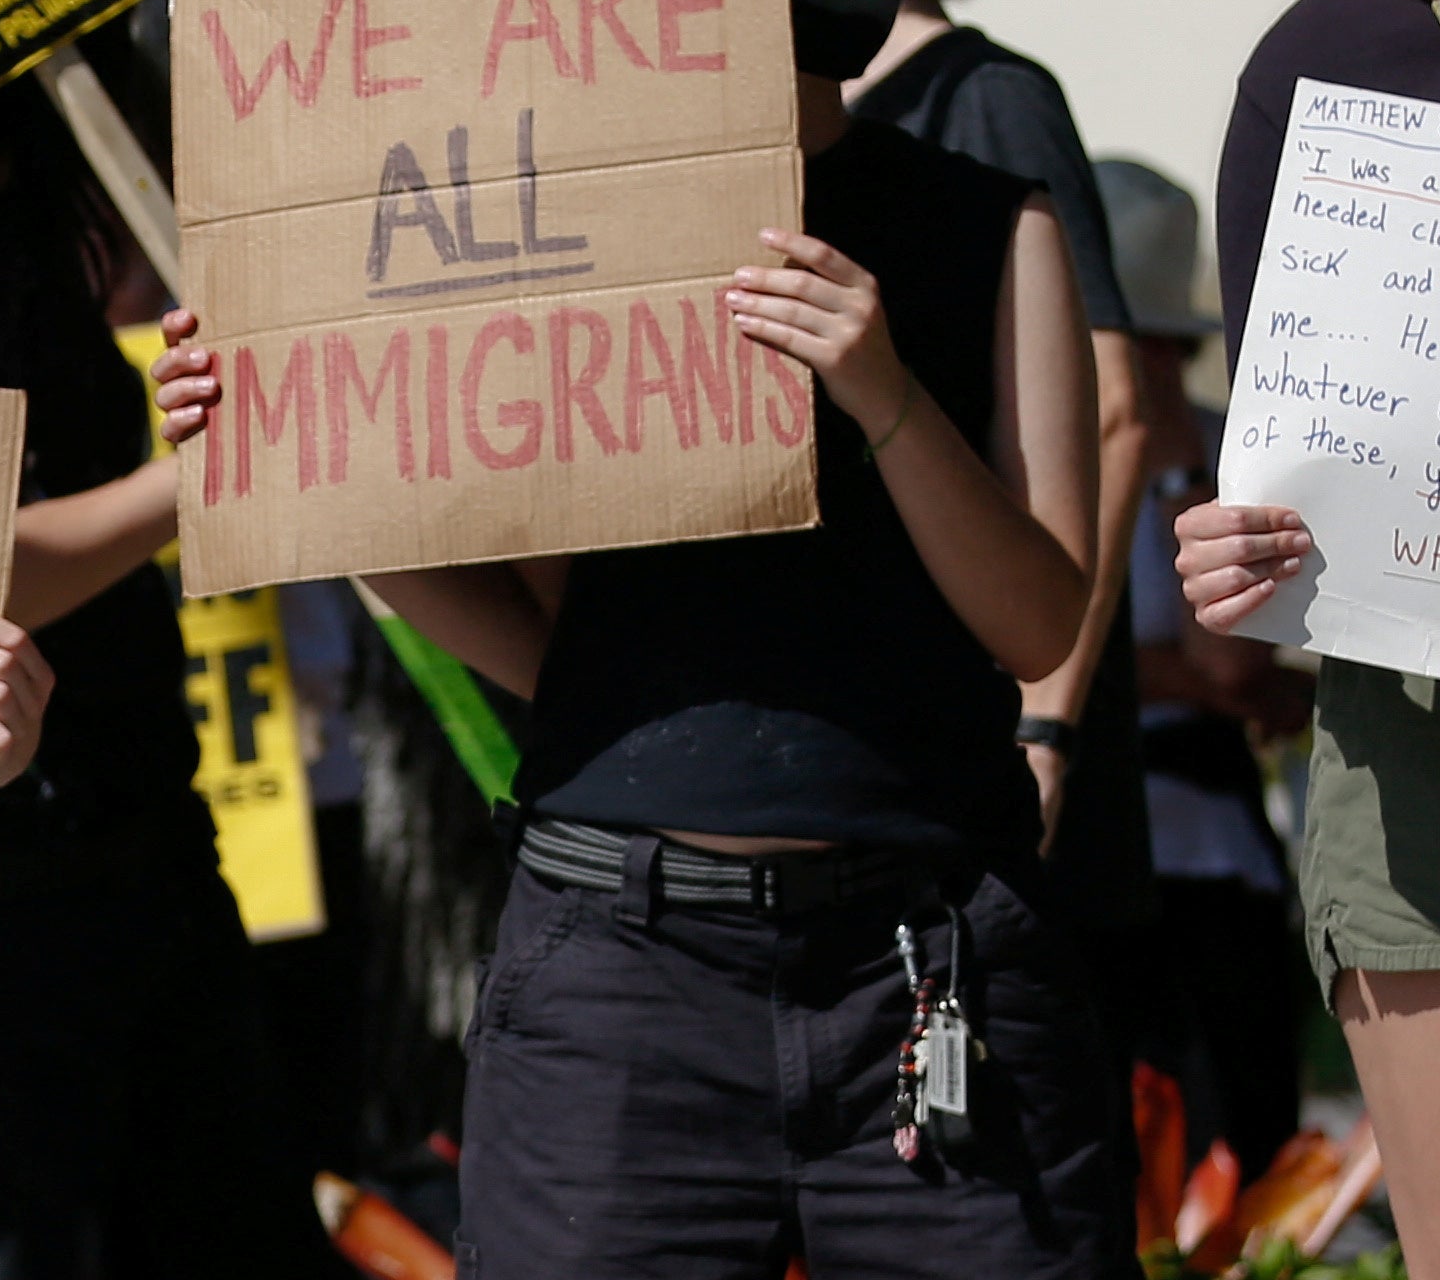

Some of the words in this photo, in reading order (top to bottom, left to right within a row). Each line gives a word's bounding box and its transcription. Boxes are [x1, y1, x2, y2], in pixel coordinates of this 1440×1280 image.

[1304, 95, 1426, 132] MATTHEW
[366, 107, 588, 282] ALL
[1351, 158, 1390, 184] was
[1422, 175, 1439, 192] a
[1293, 191, 1386, 233] needed
[1382, 268, 1432, 293] and
[1401, 314, 1438, 360] He
[1252, 351, 1410, 416] whatever
[1241, 415, 1281, 450] of
